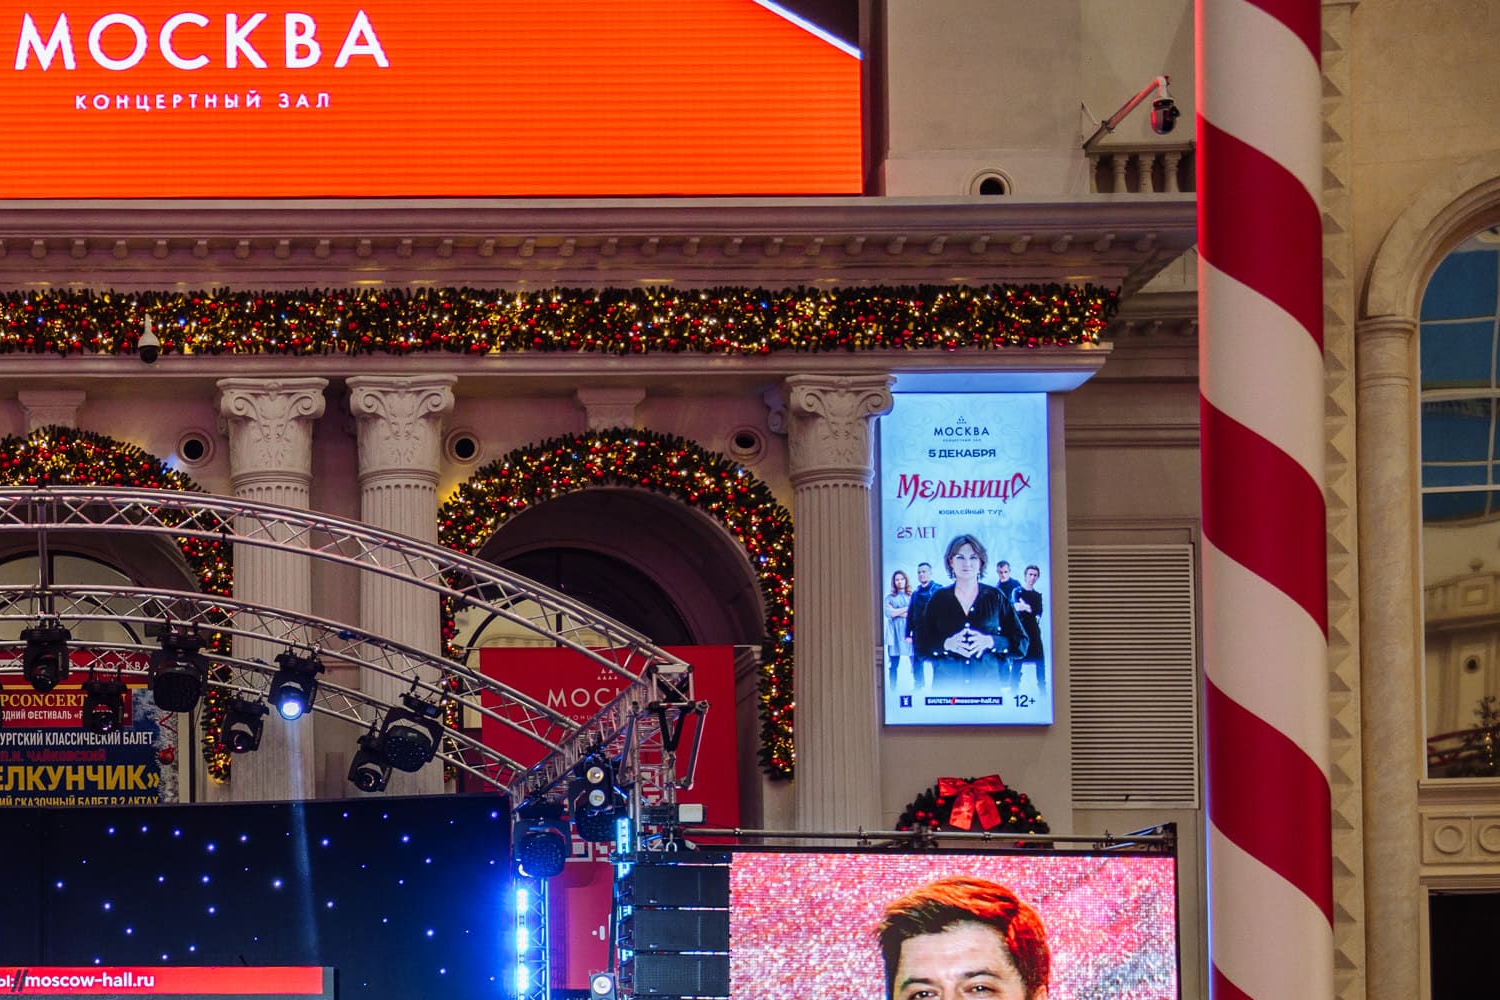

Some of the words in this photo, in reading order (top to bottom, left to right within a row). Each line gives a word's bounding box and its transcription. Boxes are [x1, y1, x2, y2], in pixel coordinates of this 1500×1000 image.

[14, 10, 390, 71] МОСКВА
[74, 90, 262, 112] КОНЦЕРТНЫЙ
[278, 92, 332, 109] ЗАЛ
[933, 427, 990, 437] МОСКВА
[928, 449, 936, 458] 5
[938, 449, 996, 459] ДЕКАБРЯ
[896, 527, 913, 539] 25
[915, 527, 937, 539] ЛЕТ
[1013, 695, 1036, 708] 12+
[28, 710, 71, 720] ФЕСТИВАЛЬ
[122, 731, 154, 745] БАЛЕТ
